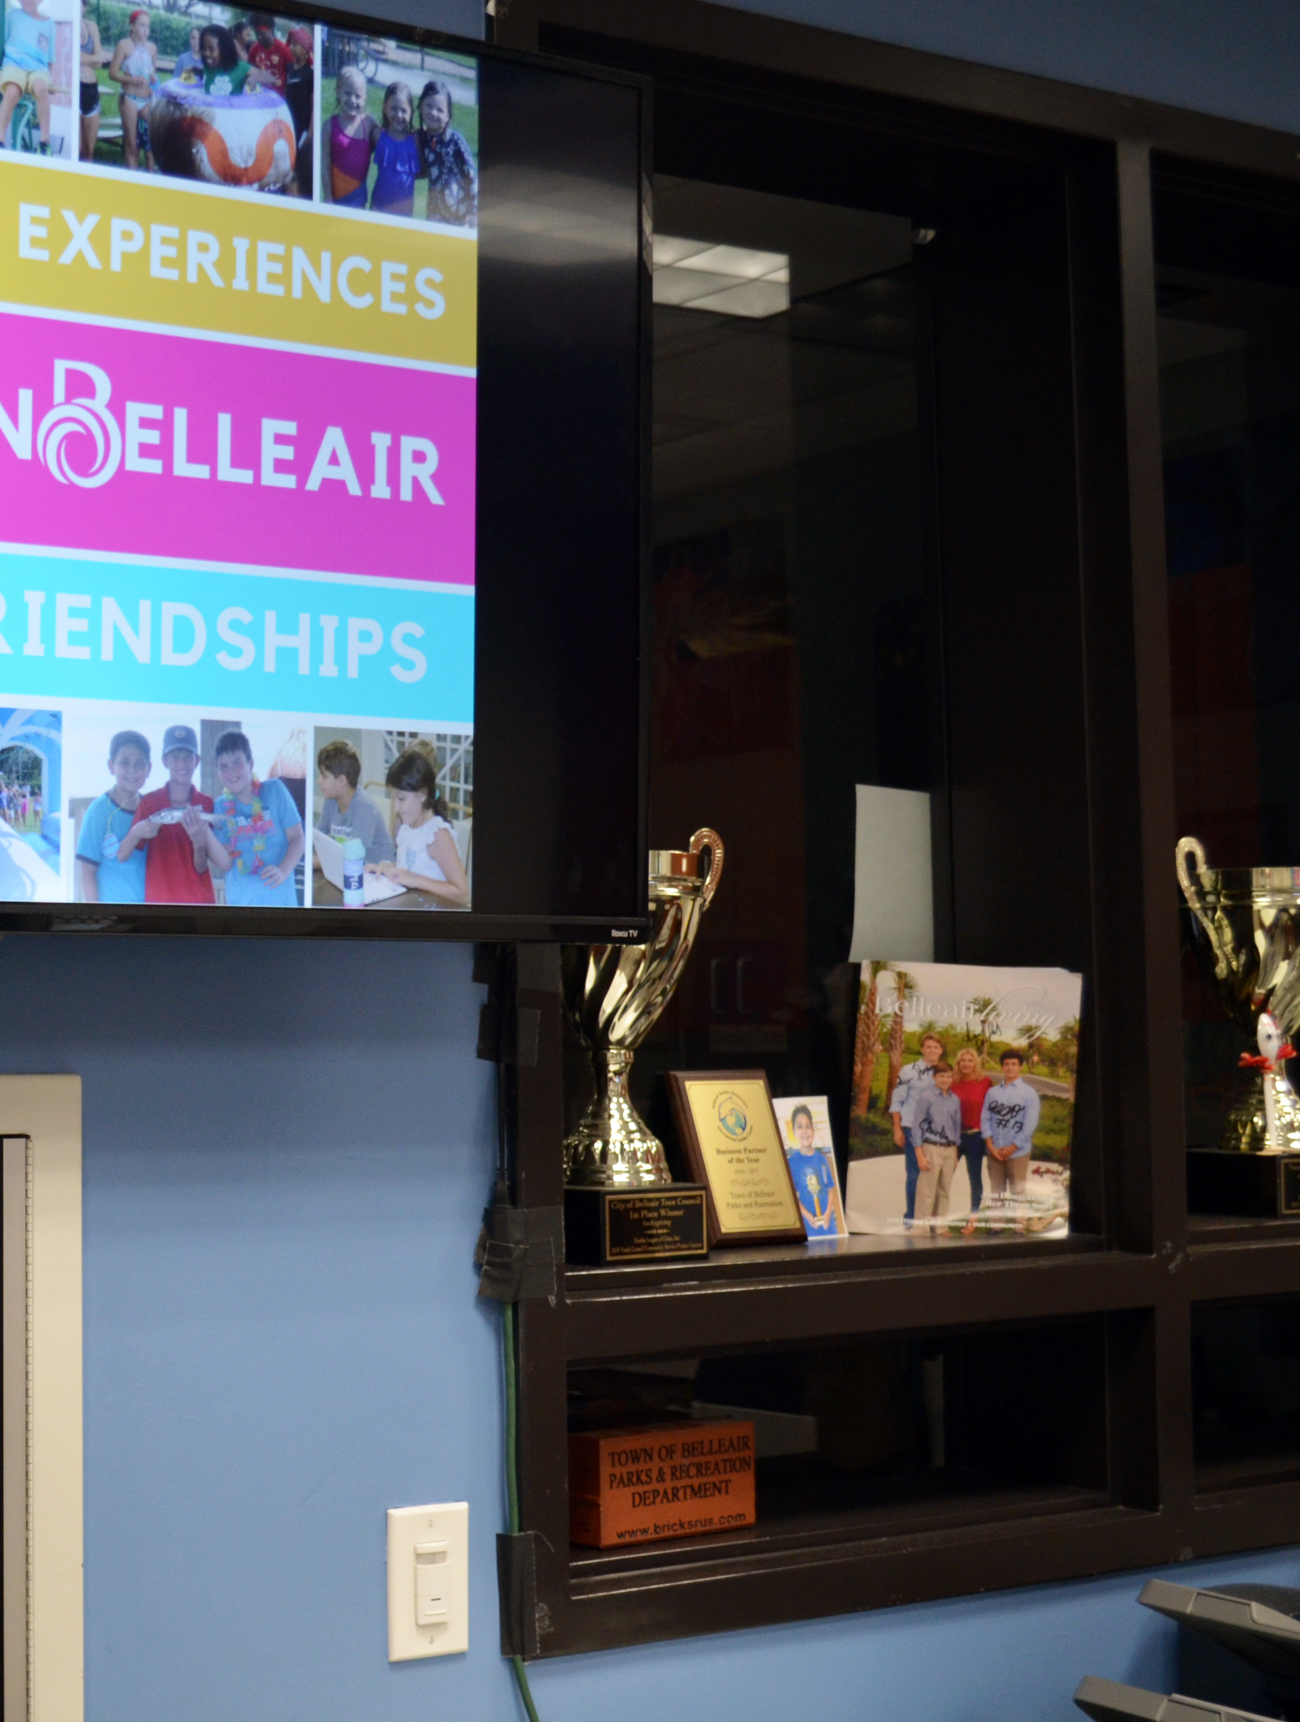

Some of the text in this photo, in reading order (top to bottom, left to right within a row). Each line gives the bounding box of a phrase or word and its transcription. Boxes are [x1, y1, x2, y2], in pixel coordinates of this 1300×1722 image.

[18, 202, 446, 321] EXPERIENCES
[628, 930, 638, 938] TV
[743, 1147, 767, 1155] Partner
[608, 1435, 751, 1468] TOWN OF BELLEAIR
[609, 1456, 752, 1490] PARKS & RECREATION
[631, 1479, 732, 1509] DEPARTMENT
[616, 1512, 746, 1541] www.bricksrus.com
